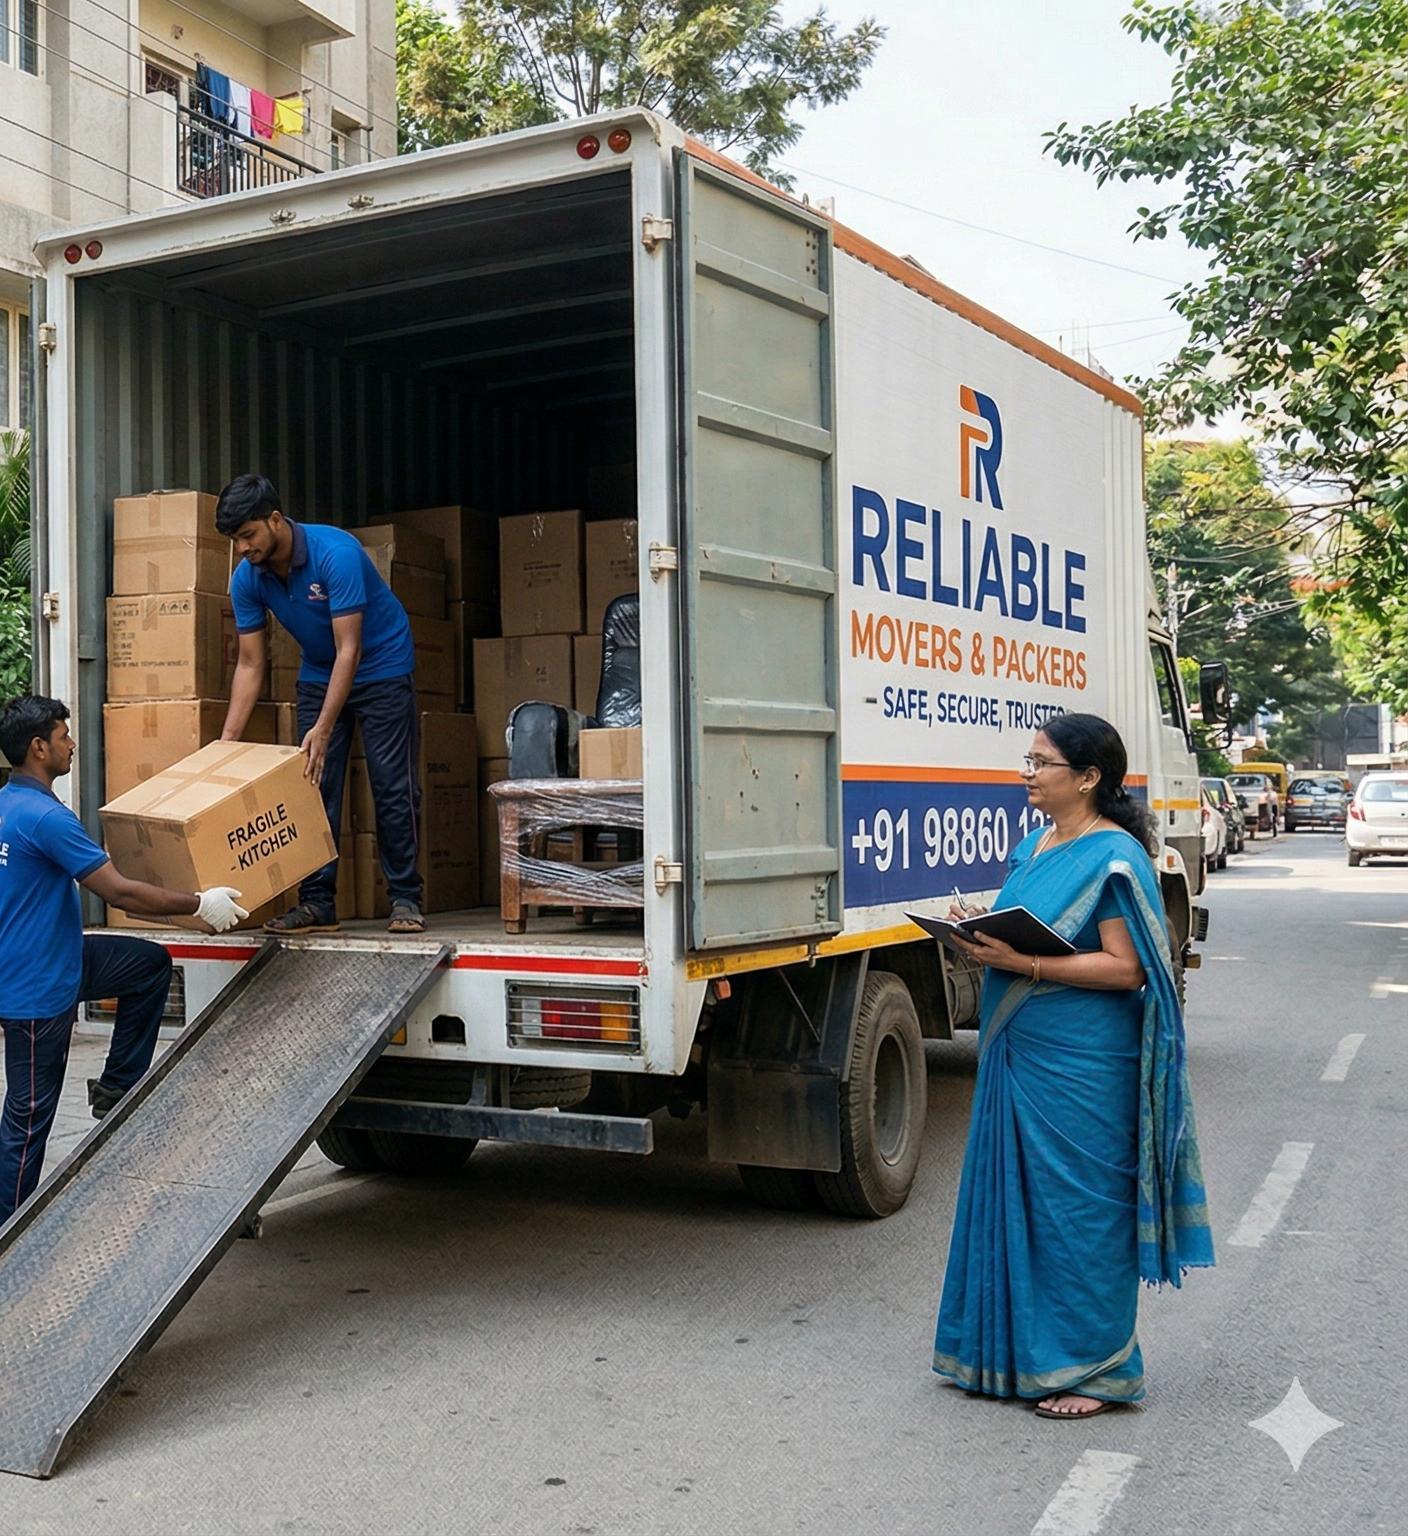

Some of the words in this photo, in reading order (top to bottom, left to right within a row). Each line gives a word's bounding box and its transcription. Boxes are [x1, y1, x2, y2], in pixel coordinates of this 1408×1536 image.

[852, 484, 1087, 634] RELIABLE
[851, 609, 963, 673] MOVERS
[970, 632, 986, 677] &
[993, 635, 1087, 691] PACKERS
[883, 686, 933, 728] SAFE,
[937, 691, 1003, 733] SECURE,
[227, 803, 288, 851] FRAGILE
[238, 822, 298, 871] KITCHEN
[851, 808, 910, 872] +91
[923, 806, 1009, 868] 98860
